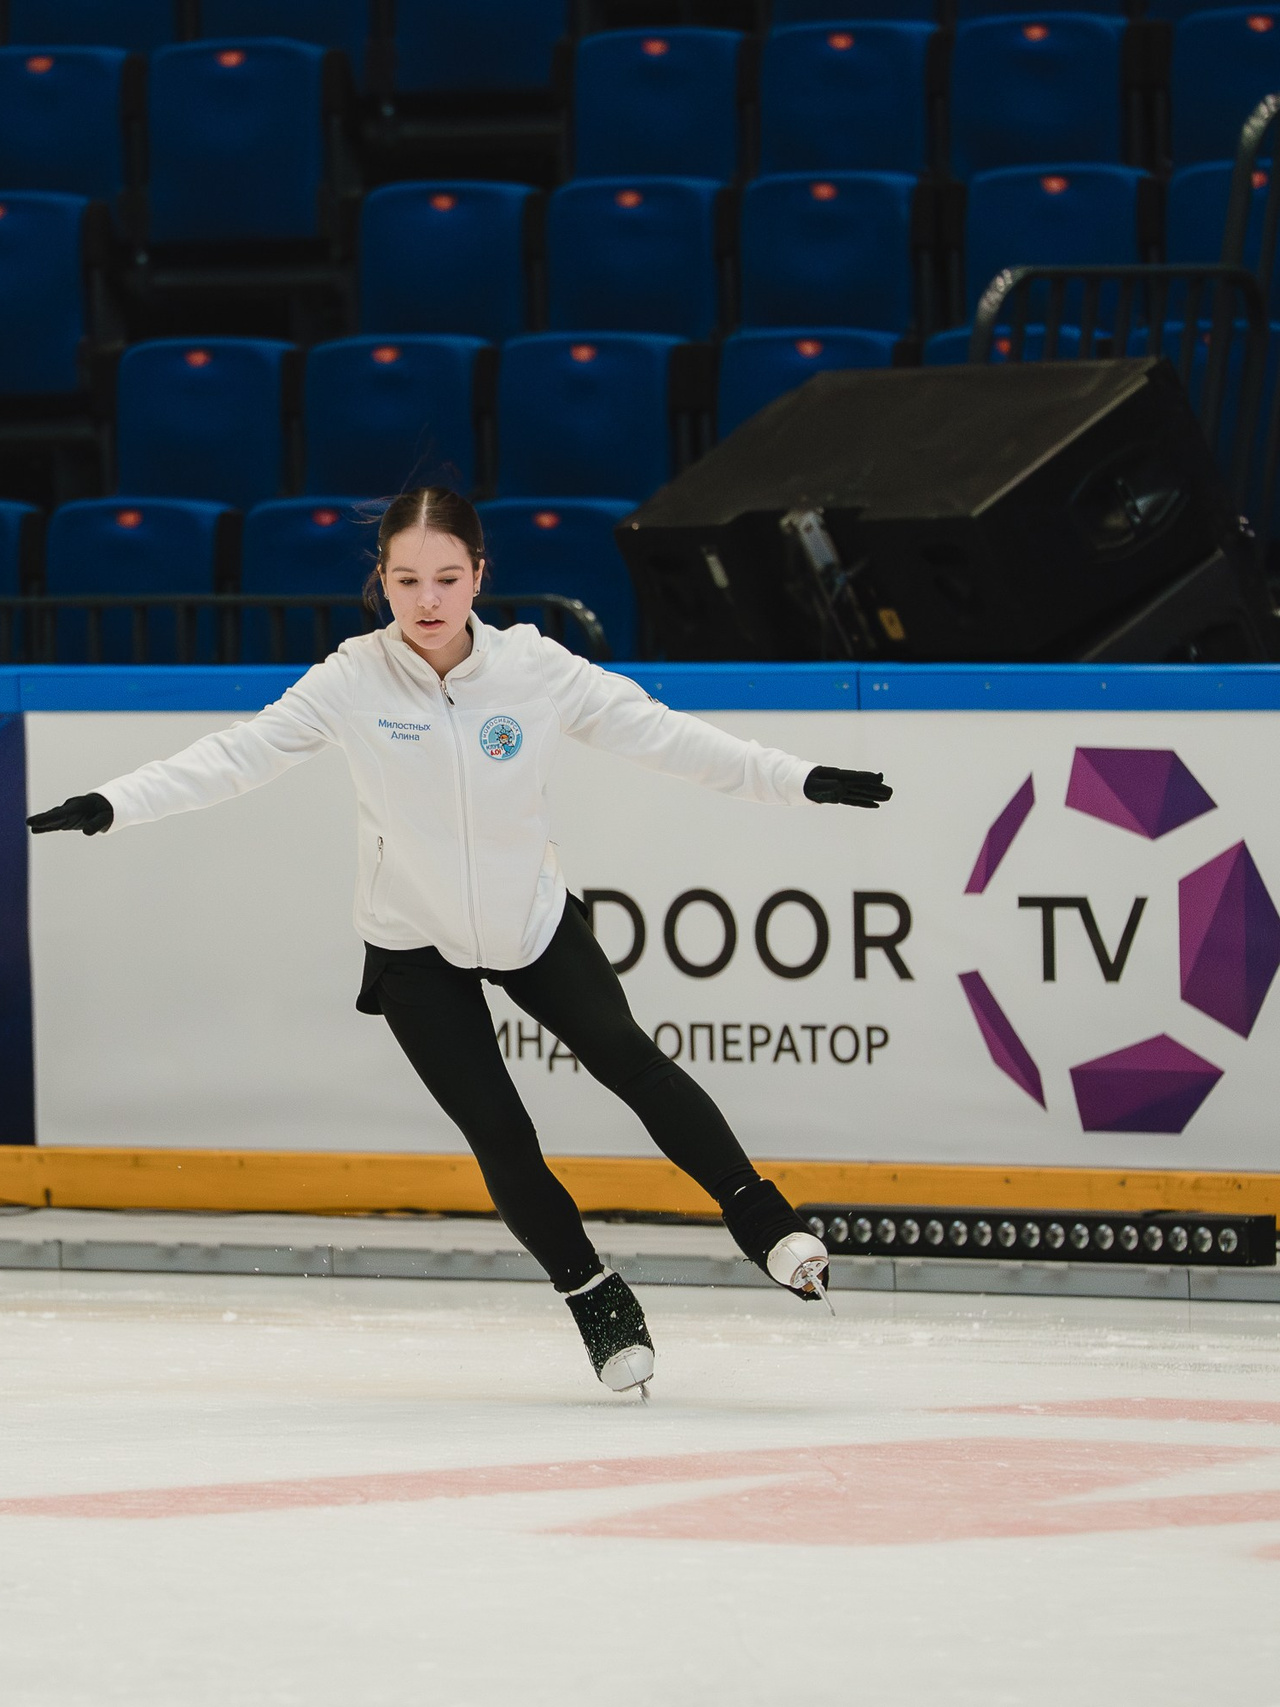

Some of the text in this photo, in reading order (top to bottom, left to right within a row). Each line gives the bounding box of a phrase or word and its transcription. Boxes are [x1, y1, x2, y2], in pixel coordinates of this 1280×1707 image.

[378, 719, 431, 731] Милостных
[391, 731, 420, 741] Алина
[582, 888, 1149, 983] DOOR TV
[654, 1022, 890, 1065] ОПЕРАТОР
